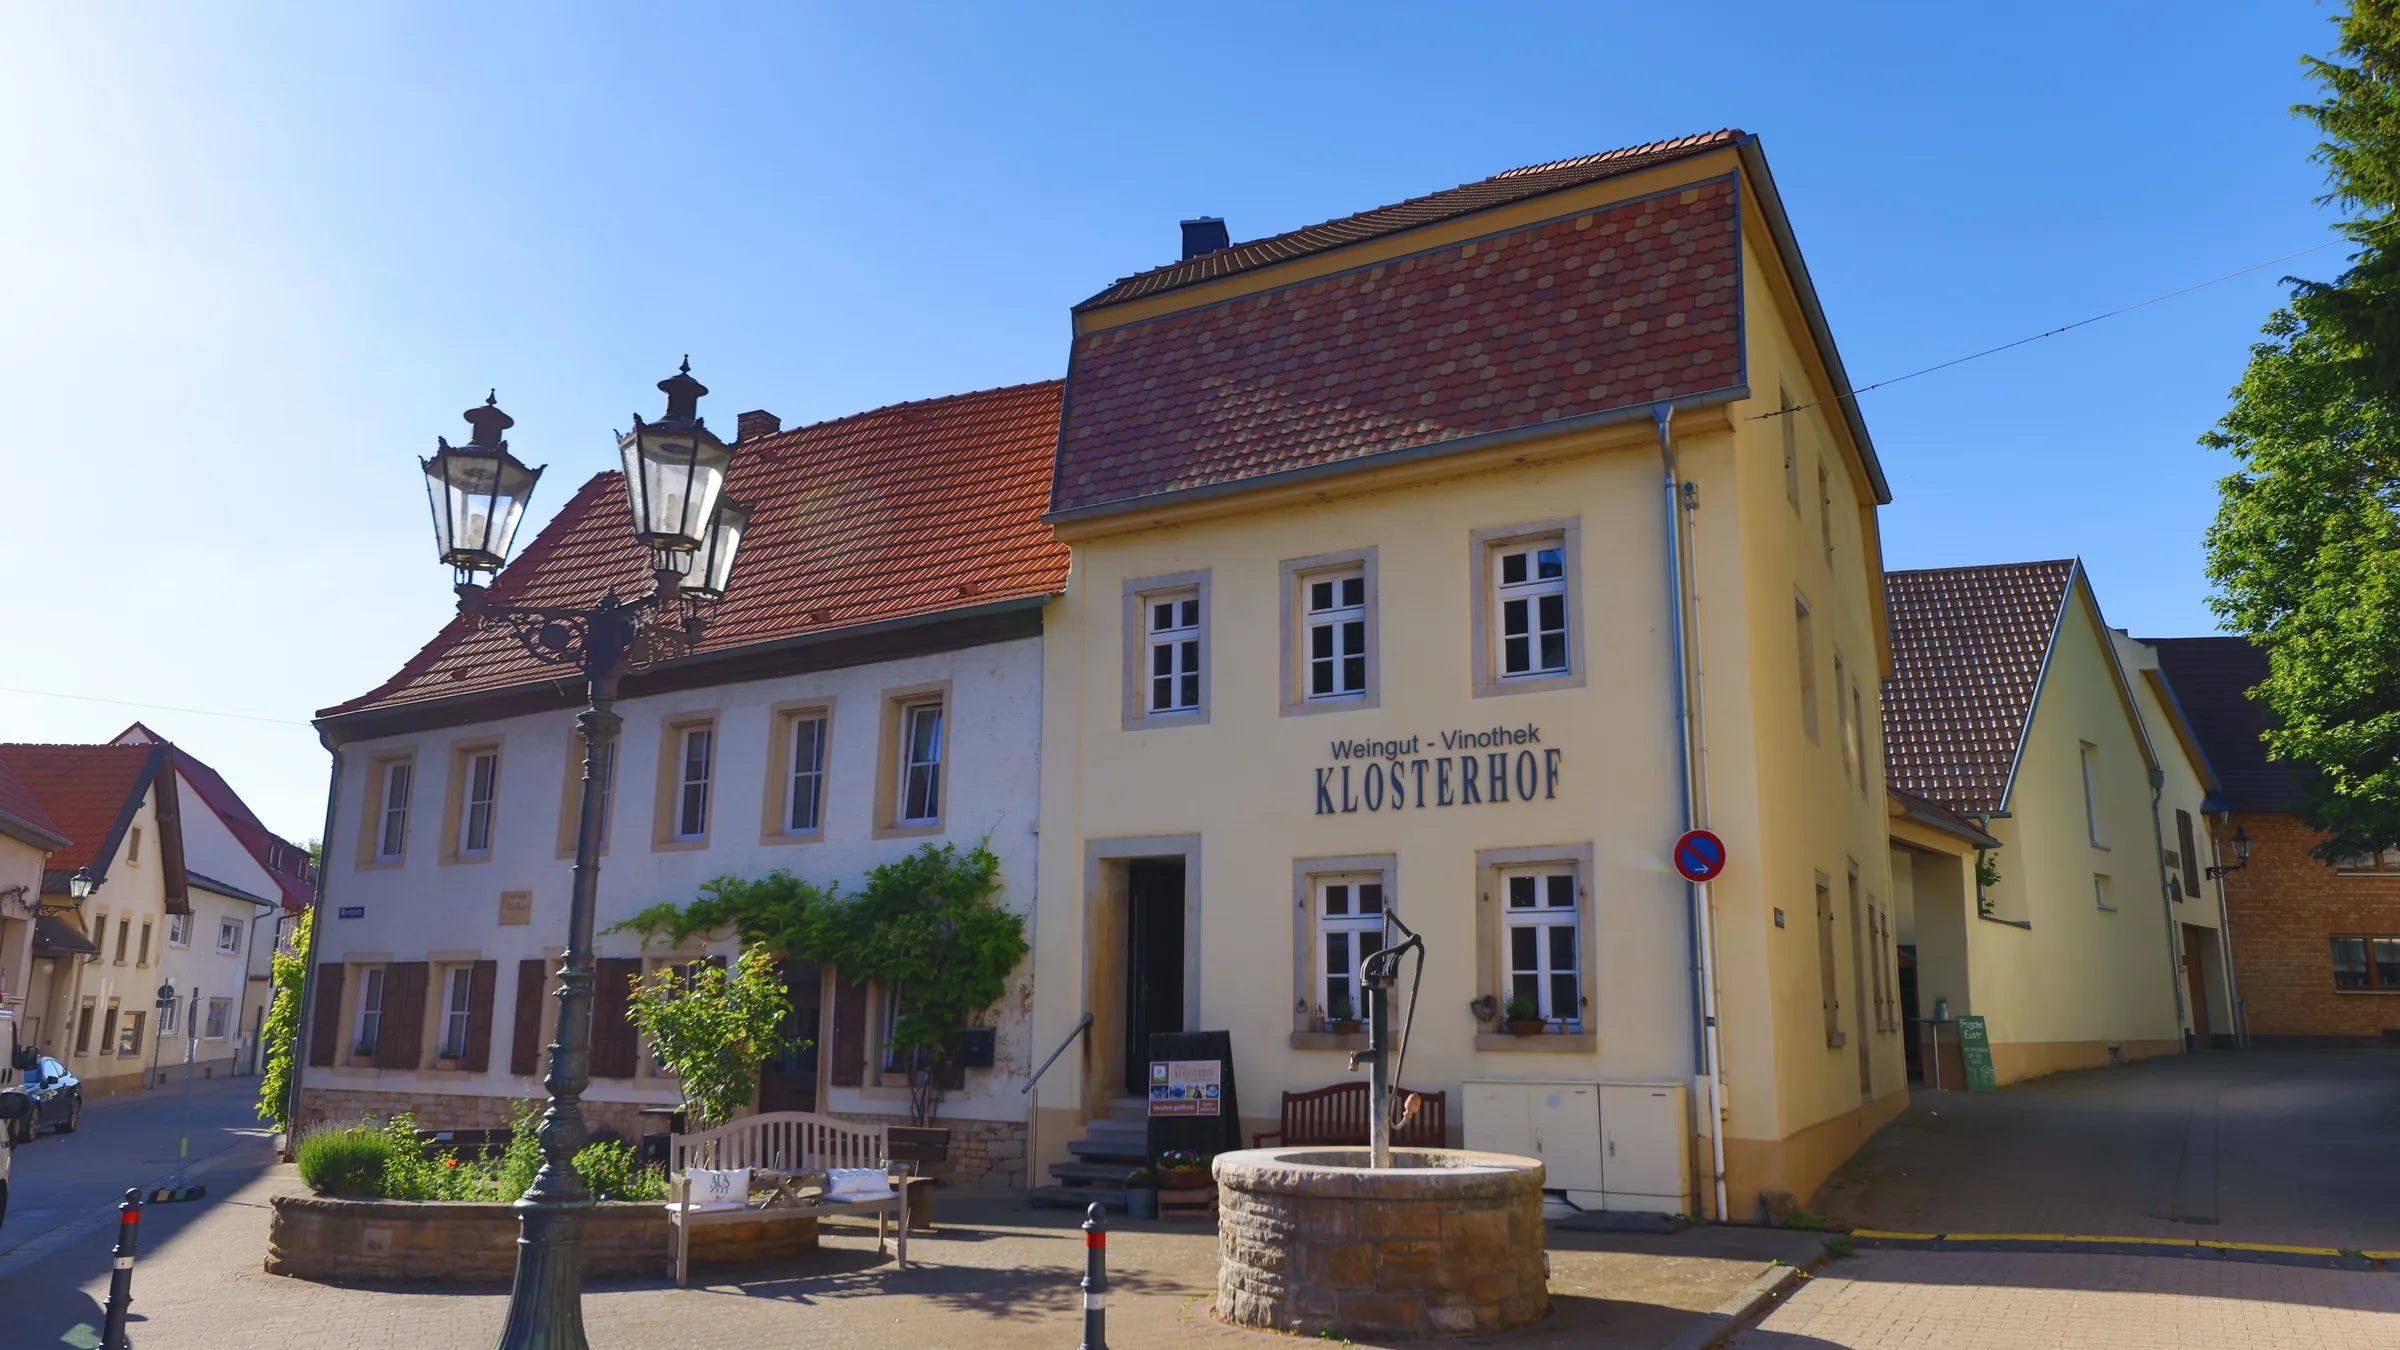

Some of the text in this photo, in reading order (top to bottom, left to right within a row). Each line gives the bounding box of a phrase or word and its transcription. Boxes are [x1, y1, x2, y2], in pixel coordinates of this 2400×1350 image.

[1331, 734, 1419, 761] Weingut
[1441, 723, 1541, 751] Vinothek
[1315, 748, 1562, 815] KLOSTERHOF
[1959, 1018, 1984, 1030] Frische
[1964, 1029, 1981, 1040] Eier
